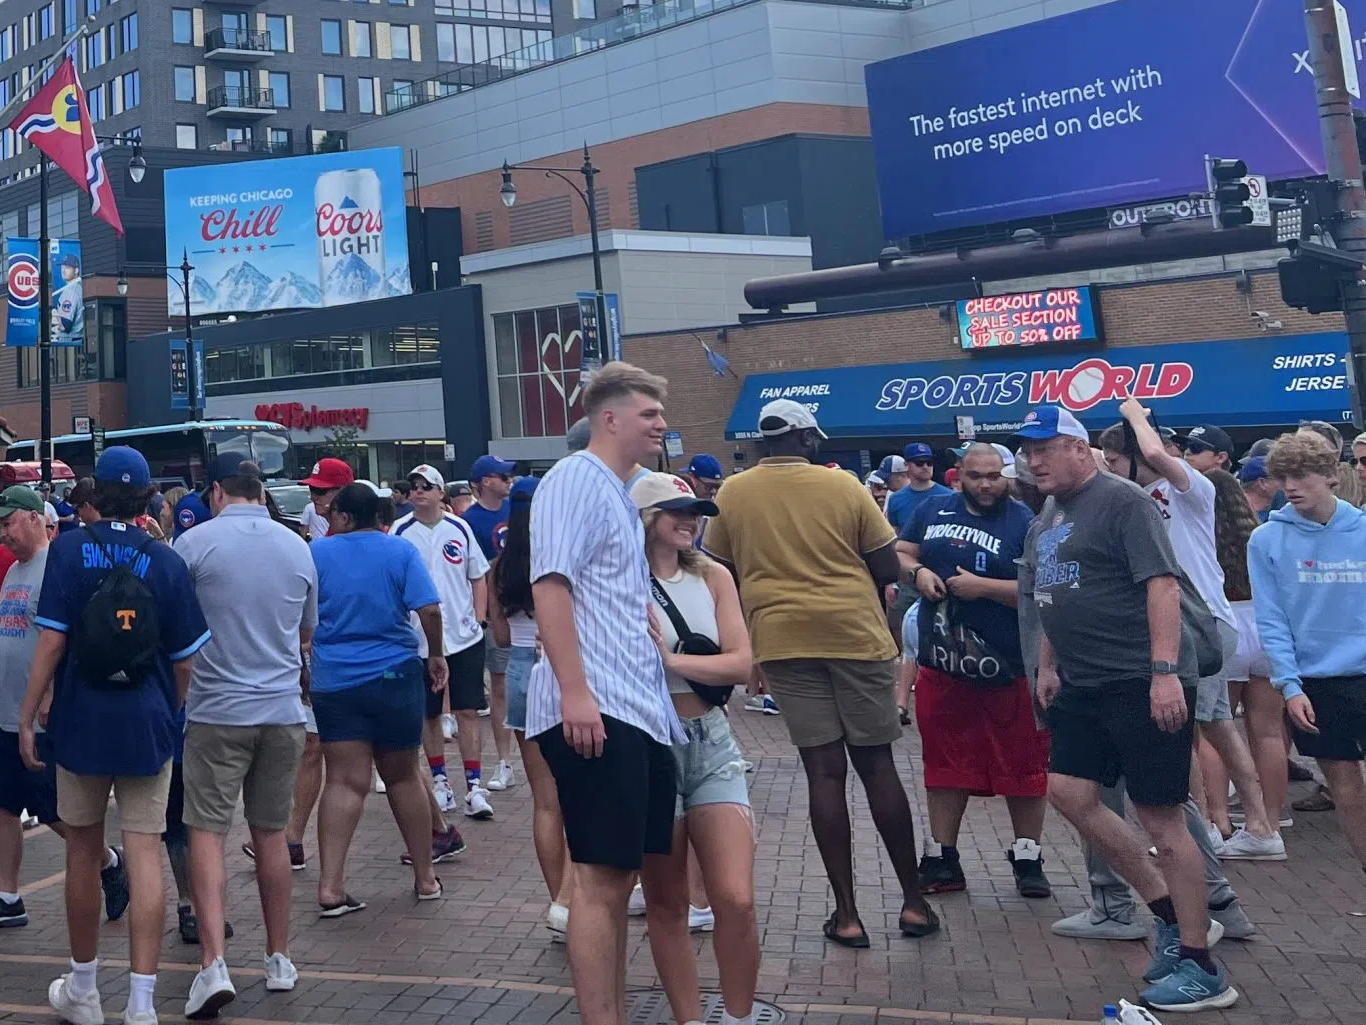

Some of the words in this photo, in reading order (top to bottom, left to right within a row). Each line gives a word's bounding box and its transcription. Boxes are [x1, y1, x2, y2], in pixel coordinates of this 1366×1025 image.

[910, 114, 944, 136] The
[949, 98, 1016, 128] fastest
[1021, 78, 1106, 113] internet
[1111, 65, 1162, 95] with
[934, 137, 983, 160] more
[989, 118, 1048, 154] speed
[1054, 117, 1081, 136] on
[1088, 100, 1142, 129] deck
[190, 192, 237, 207] KEEPING
[240, 188, 293, 203] CHICAGO
[200, 204, 284, 242] Chill
[316, 203, 383, 238] Coors
[323, 235, 380, 257] LIGHT
[965, 293, 1043, 315] CHECKOUT
[1046, 290, 1081, 306] OUR
[970, 313, 1009, 330] SALE
[1012, 306, 1077, 328] SECTION
[972, 332, 991, 347] UP
[995, 331, 1015, 344] TO
[1020, 328, 1049, 343] 50%
[1052, 325, 1081, 341] OFF
[1272, 353, 1336, 369] SHIRTS
[760, 387, 782, 398] FAN
[781, 384, 831, 397] APPAREL
[875, 372, 1027, 411] SPORTS
[1285, 376, 1349, 391] JERSE
[924, 524, 1001, 555] WRIGLEYVILLE
[116, 609, 136, 631] T
[933, 644, 1000, 678] RICO
